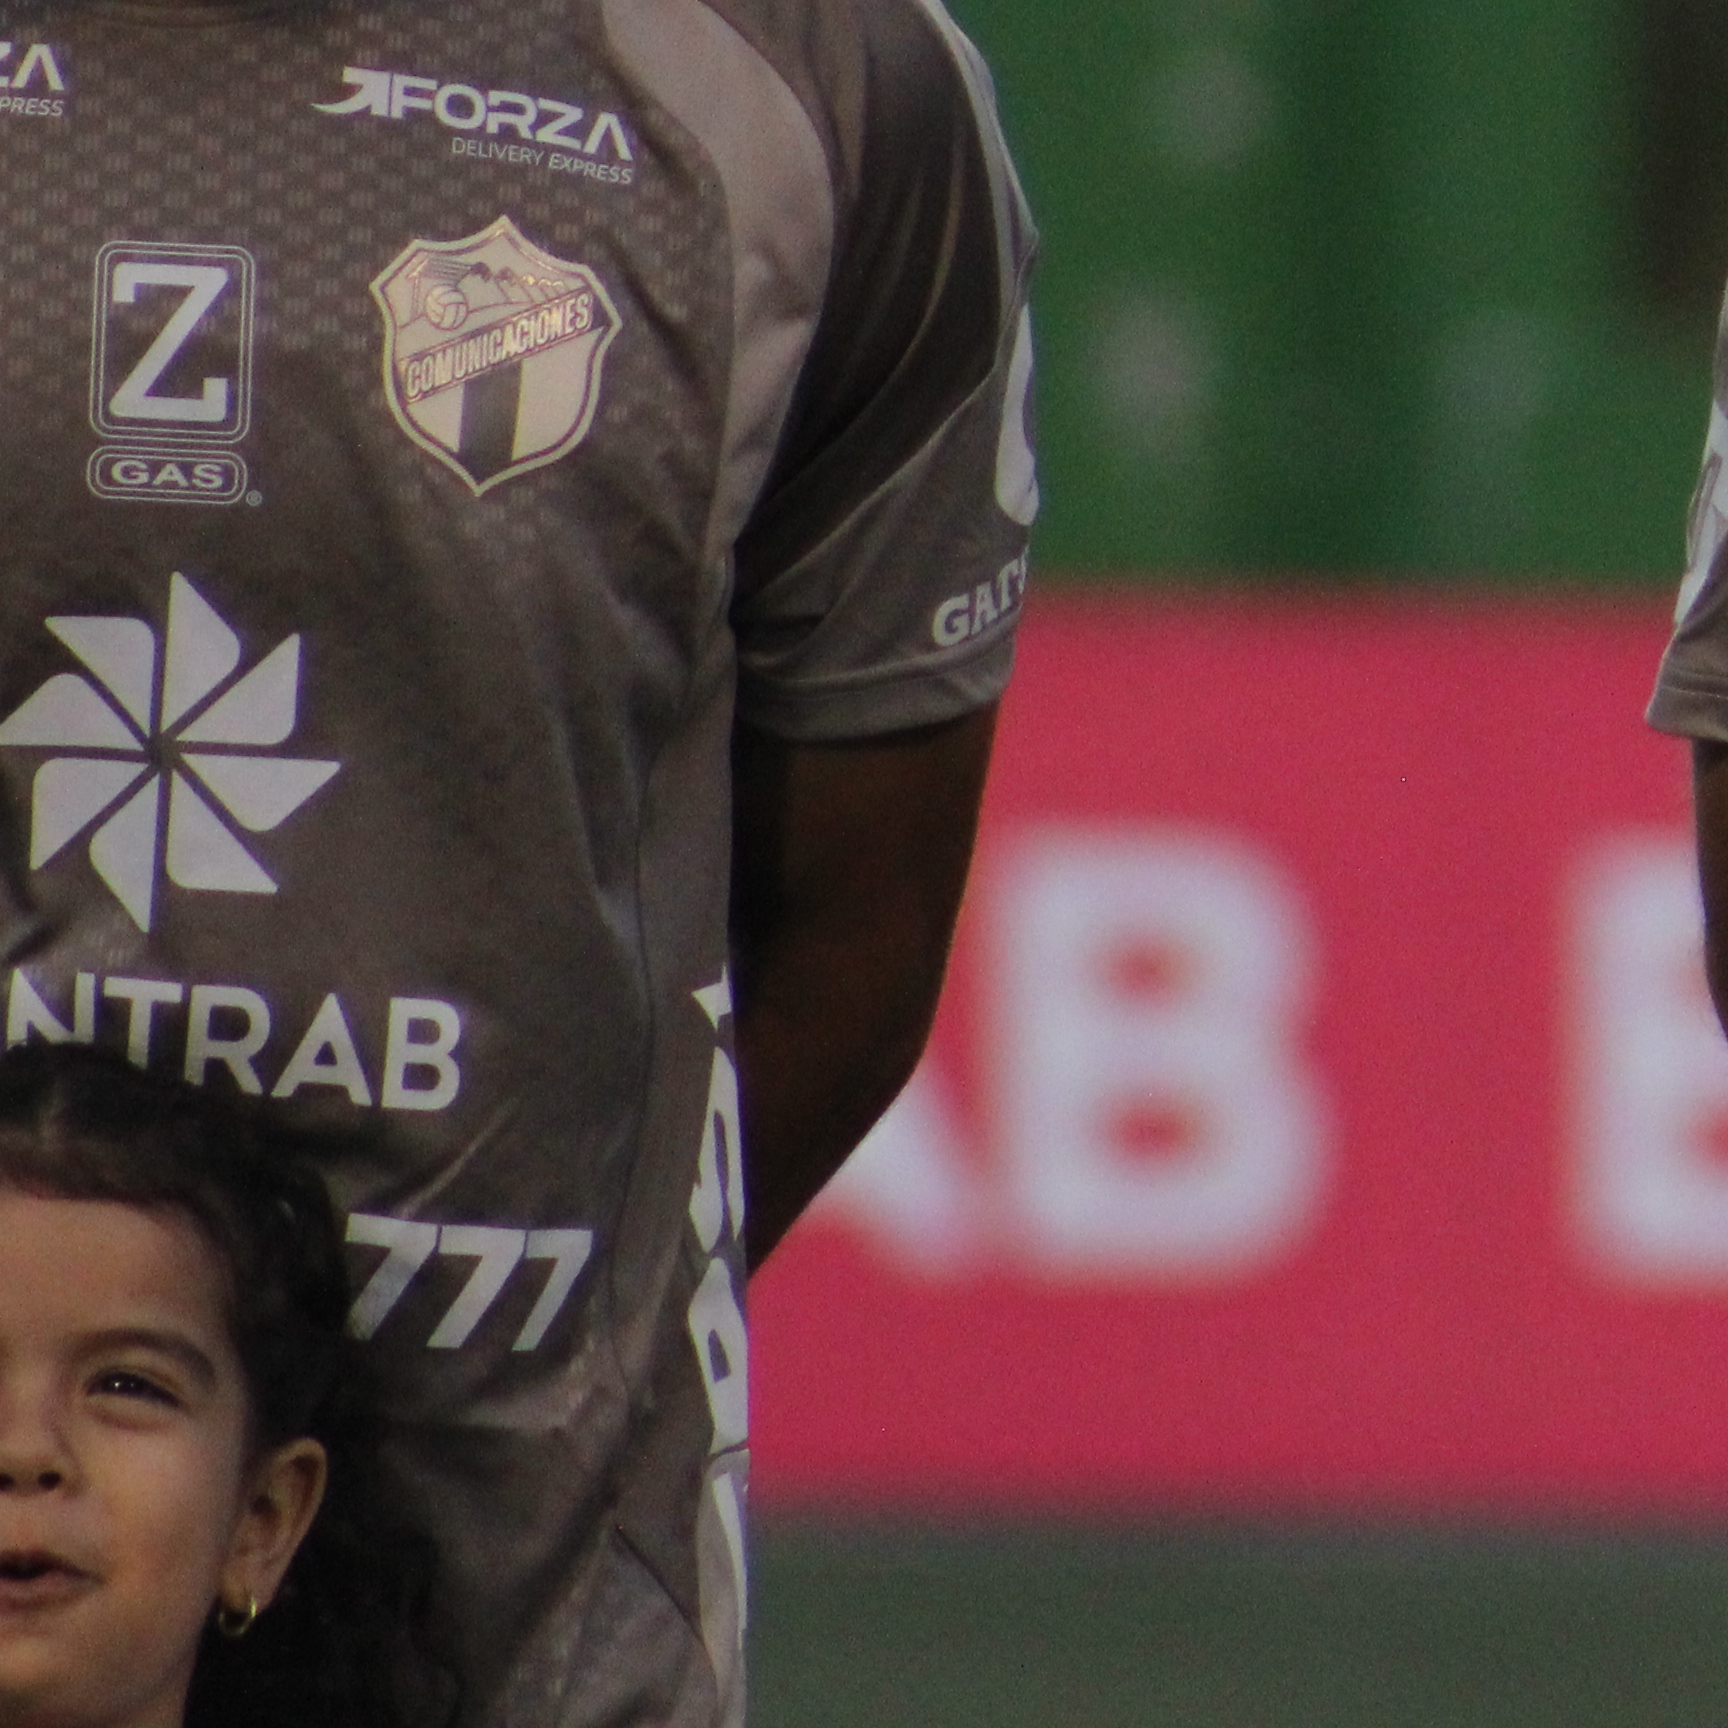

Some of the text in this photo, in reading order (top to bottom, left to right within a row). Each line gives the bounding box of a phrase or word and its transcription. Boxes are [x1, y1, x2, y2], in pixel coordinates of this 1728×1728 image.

[390, 72, 634, 162] FORZA
[452, 136, 634, 185] DELIVERY EXPRESS
[109, 261, 229, 422] Z
[406, 292, 593, 398] COMUNICACIONES
[110, 458, 225, 491] GAS
